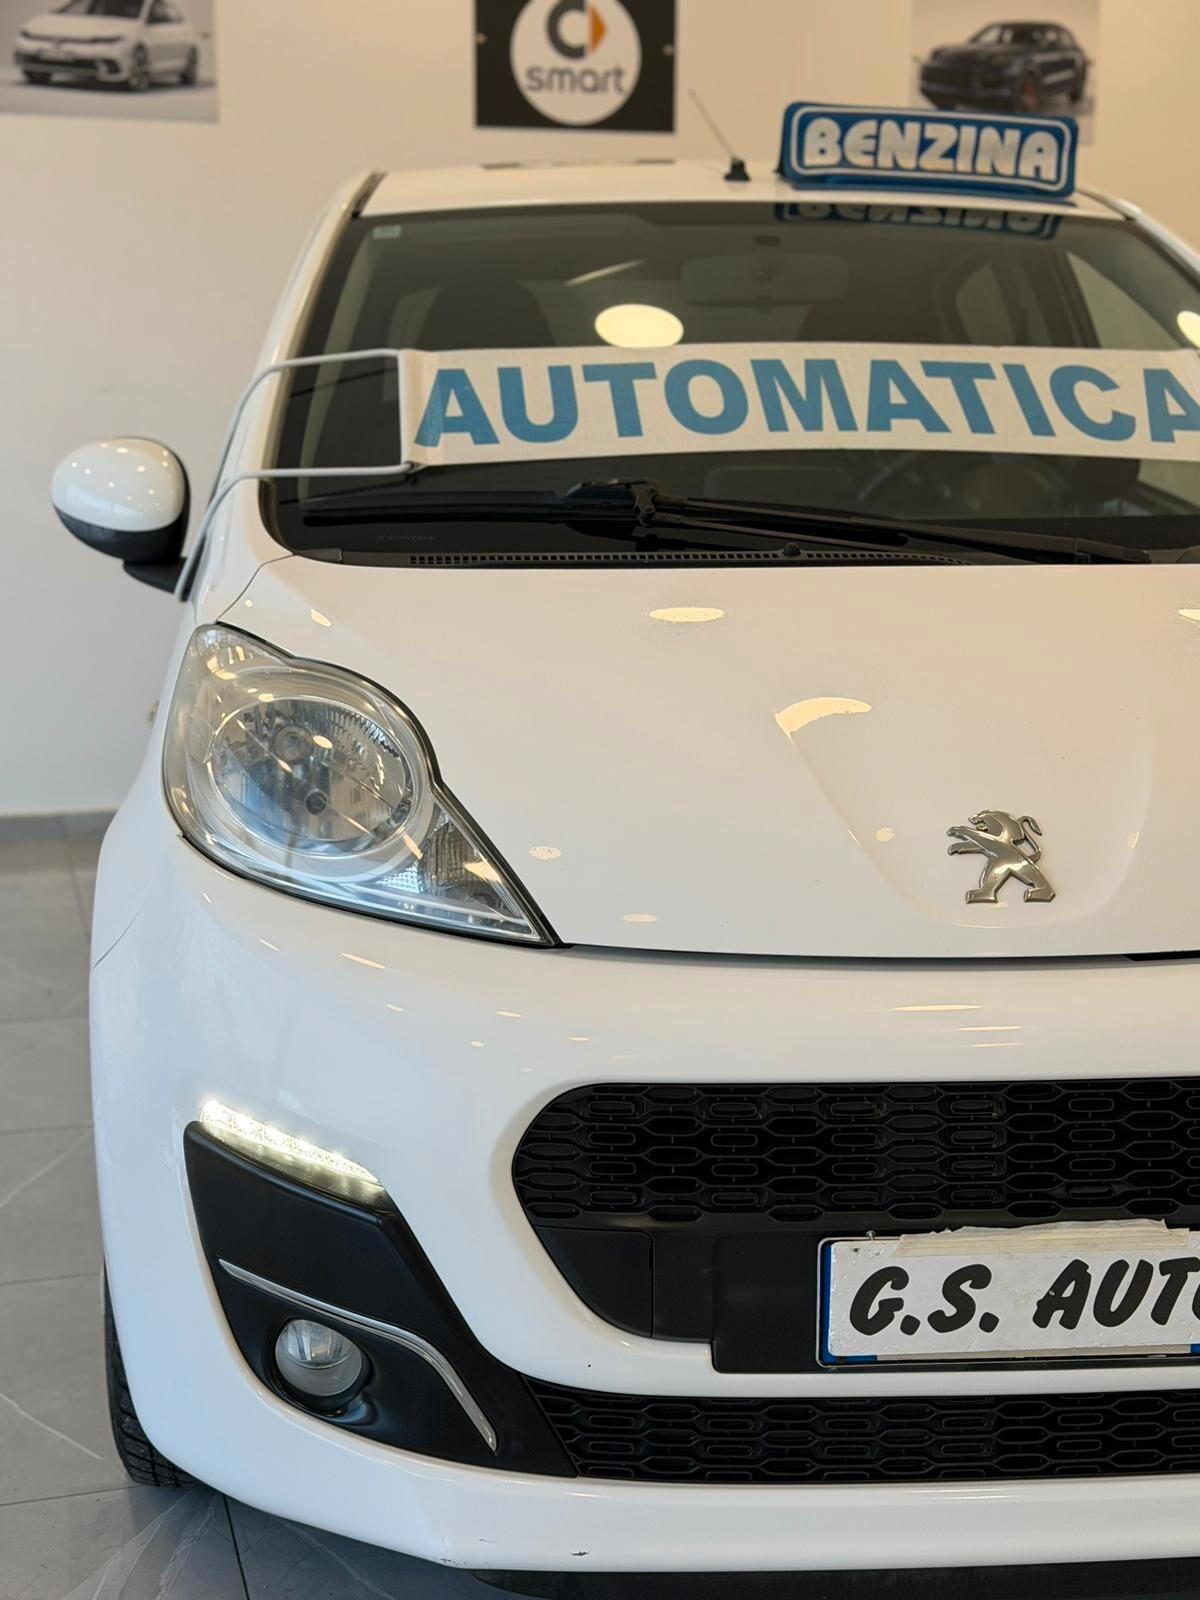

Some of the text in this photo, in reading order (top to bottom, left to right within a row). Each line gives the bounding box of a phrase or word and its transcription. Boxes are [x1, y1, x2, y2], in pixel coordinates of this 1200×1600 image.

[526, 66, 624, 95] smart
[803, 117, 1058, 182] BENZINA
[414, 359, 1200, 446] AUTOMATICA
[849, 1256, 1200, 1336] G.S. AUT
